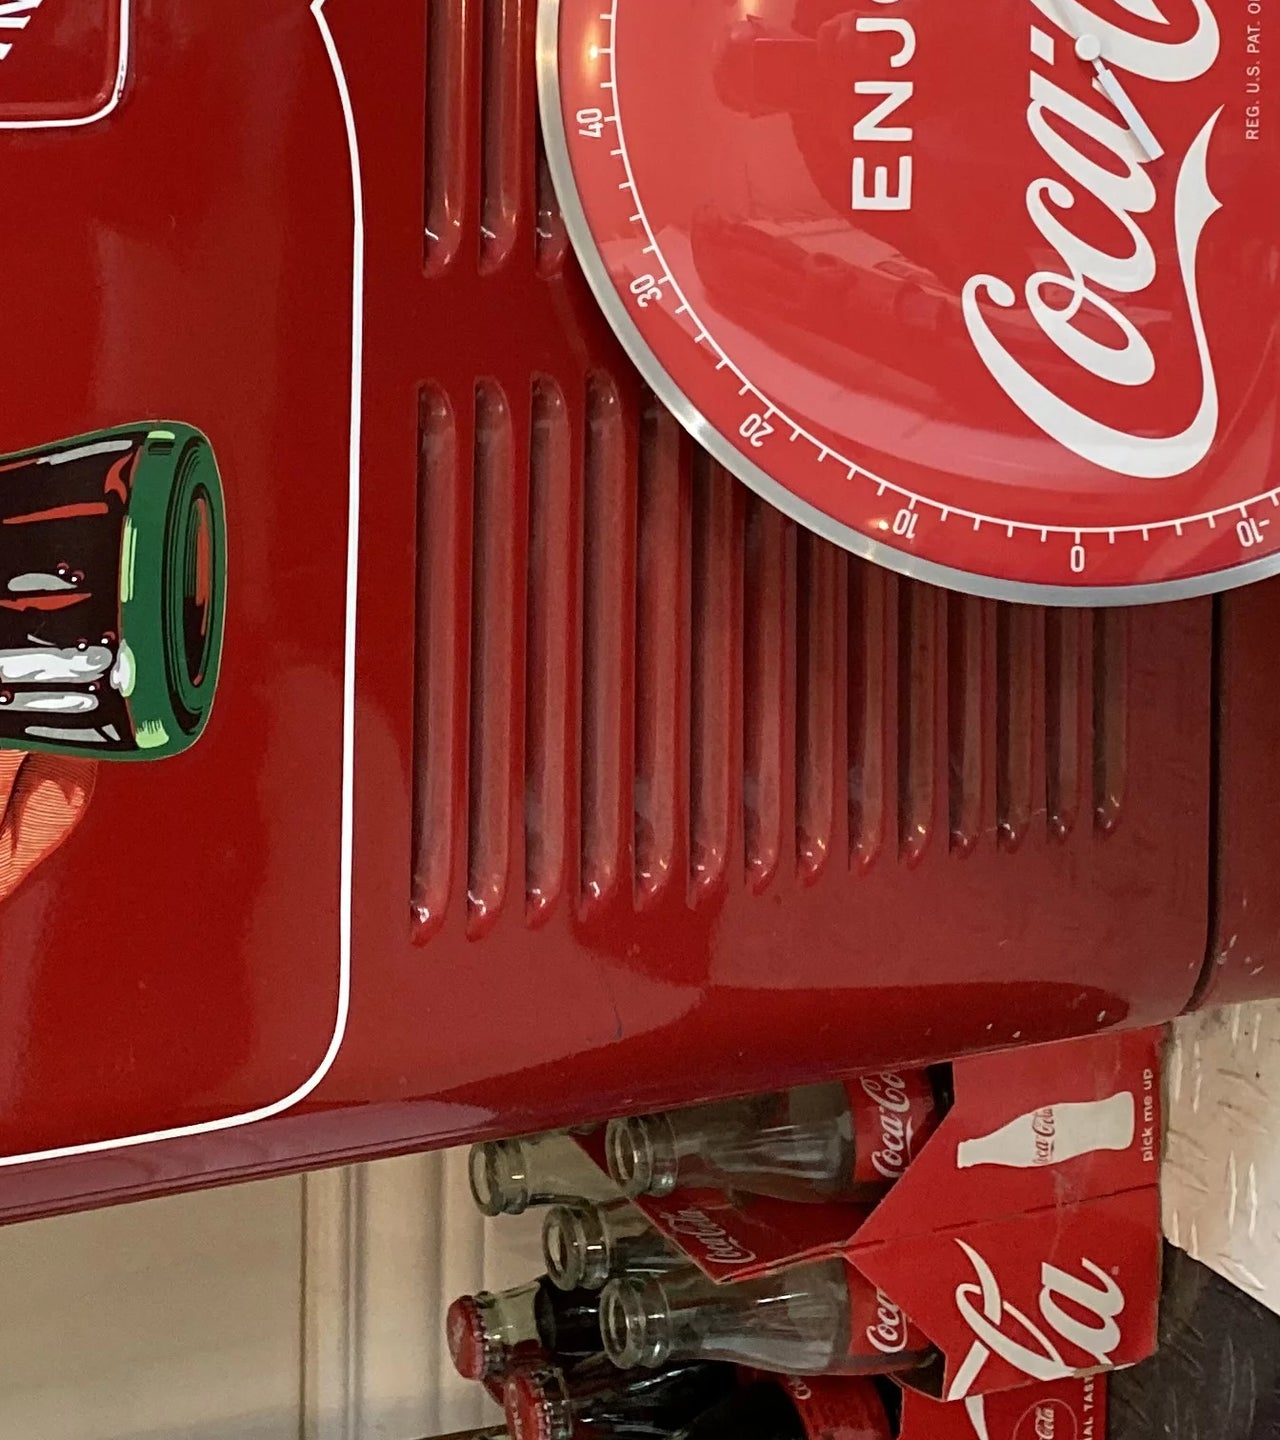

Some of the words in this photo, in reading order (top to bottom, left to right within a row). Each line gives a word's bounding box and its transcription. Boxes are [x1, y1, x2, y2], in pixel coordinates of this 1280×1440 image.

[1246, 20, 1262, 54] PAT.
[1246, 60, 1261, 94] U.S.
[576, 108, 604, 138] 40
[1245, 99, 1261, 140] REG.
[630, 274, 662, 307] 30
[739, 414, 774, 447] 20
[892, 509, 919, 539] 10
[1236, 518, 1270, 547] -10
[1070, 546, 1085, 573] 0
[1142, 1067, 1154, 1090] up
[1143, 1095, 1153, 1122] me
[1141, 1126, 1154, 1162] pick
